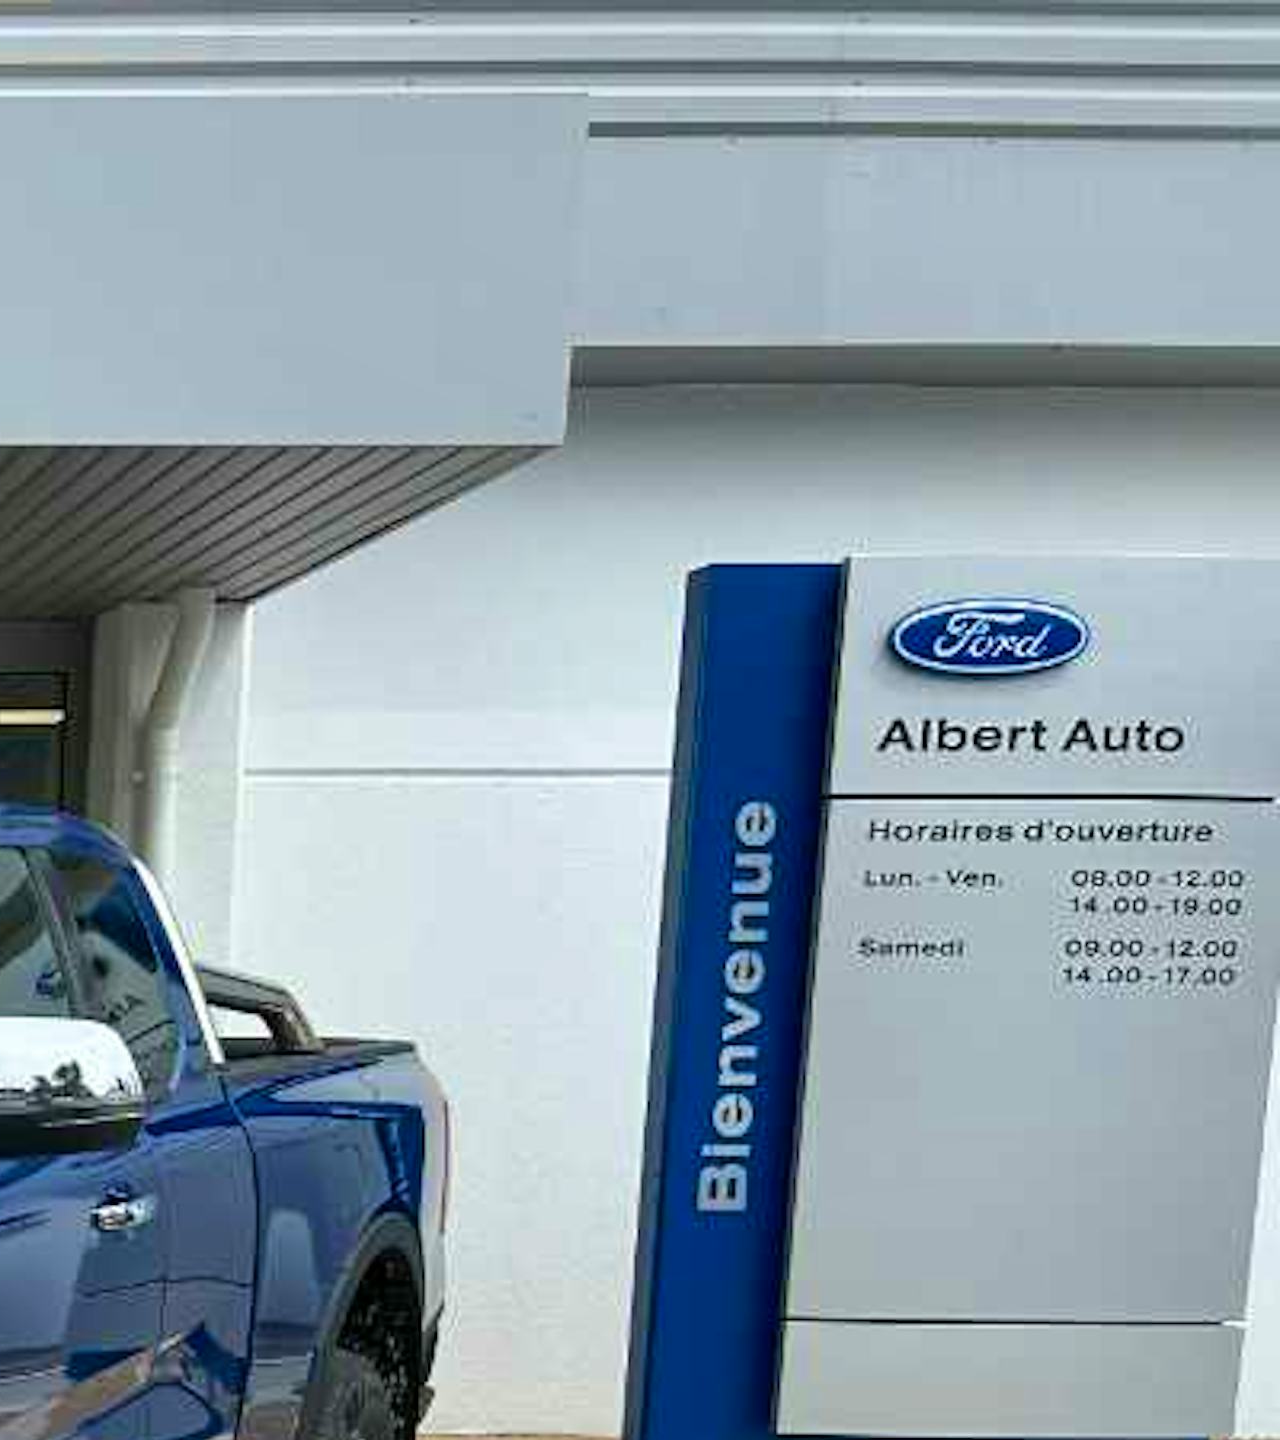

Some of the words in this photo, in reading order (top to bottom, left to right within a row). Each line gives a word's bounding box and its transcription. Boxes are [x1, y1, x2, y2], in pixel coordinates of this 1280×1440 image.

[933, 611, 1053, 660] Ford
[877, 719, 1048, 753] Albert
[1062, 719, 1186, 753] Auto
[868, 819, 1014, 843] Horaires
[1023, 819, 1215, 843] d'ouverture
[863, 869, 921, 887] Lun.
[946, 869, 1004, 888] Ven.
[858, 938, 964, 957] Samedi
[696, 800, 777, 1212] Bienvenue
